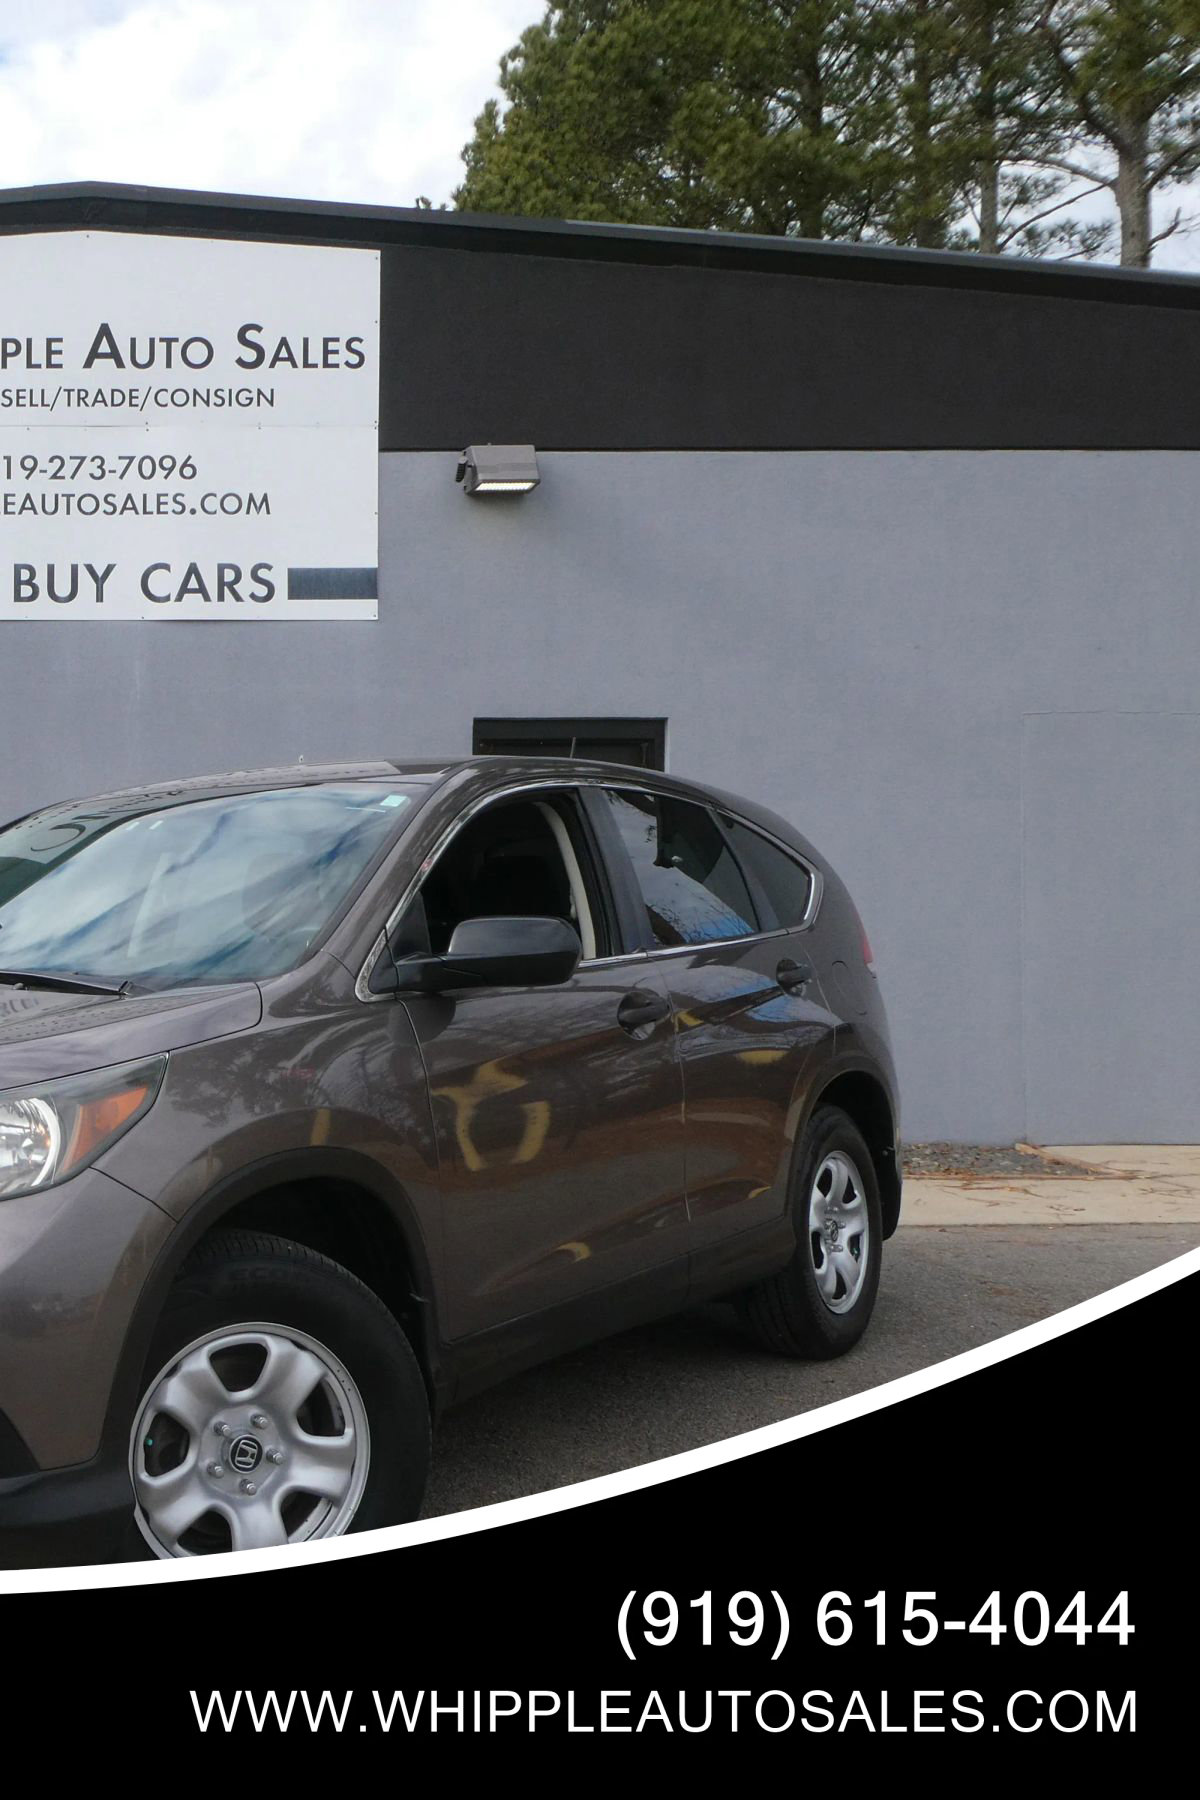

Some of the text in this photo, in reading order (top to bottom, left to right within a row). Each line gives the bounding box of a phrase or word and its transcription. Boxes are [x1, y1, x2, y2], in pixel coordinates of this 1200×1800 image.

[82, 322, 214, 370] AUTO
[235, 322, 366, 370] SALES
[0, 385, 275, 412] SELL/TRADE/CONSIGN
[13, 563, 117, 604] BUY
[140, 562, 276, 604] CARS
